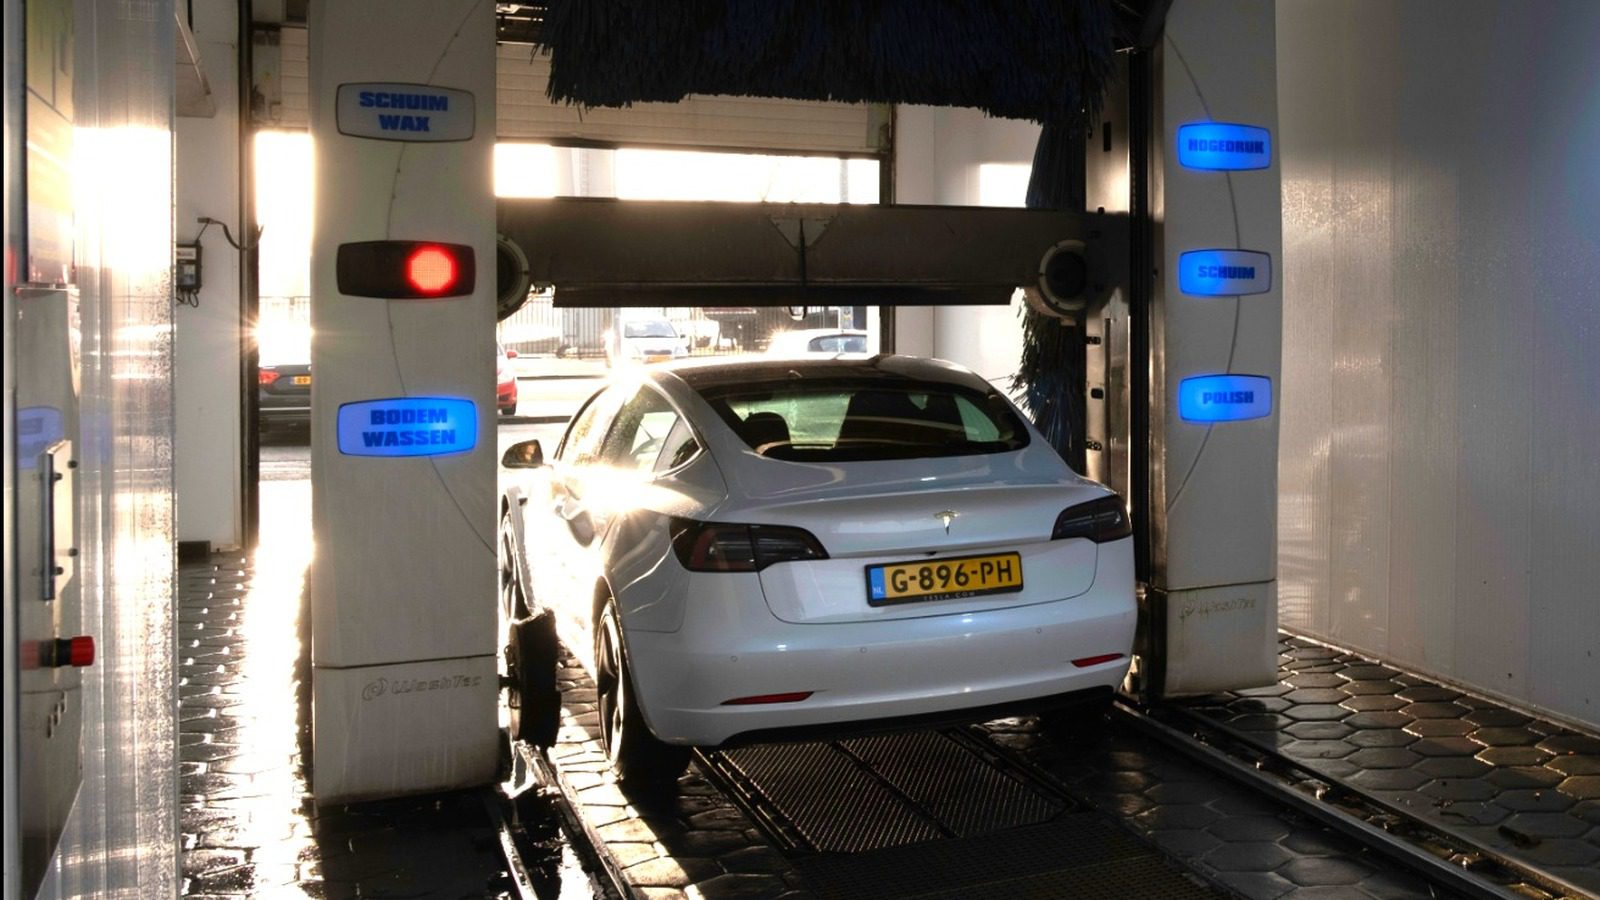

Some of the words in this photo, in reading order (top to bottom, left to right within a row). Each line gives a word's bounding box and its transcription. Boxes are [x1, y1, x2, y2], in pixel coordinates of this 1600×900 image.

[359, 91, 448, 112] SCHUIM
[378, 114, 430, 132] WAX
[1188, 139, 1264, 155] HOGEDRUK
[1198, 265, 1255, 280] SCHUIM
[1203, 391, 1254, 405] POLISH
[370, 408, 448, 425] BODEM
[362, 429, 456, 447] WASSEN
[891, 559, 1012, 593] G-896-PH
